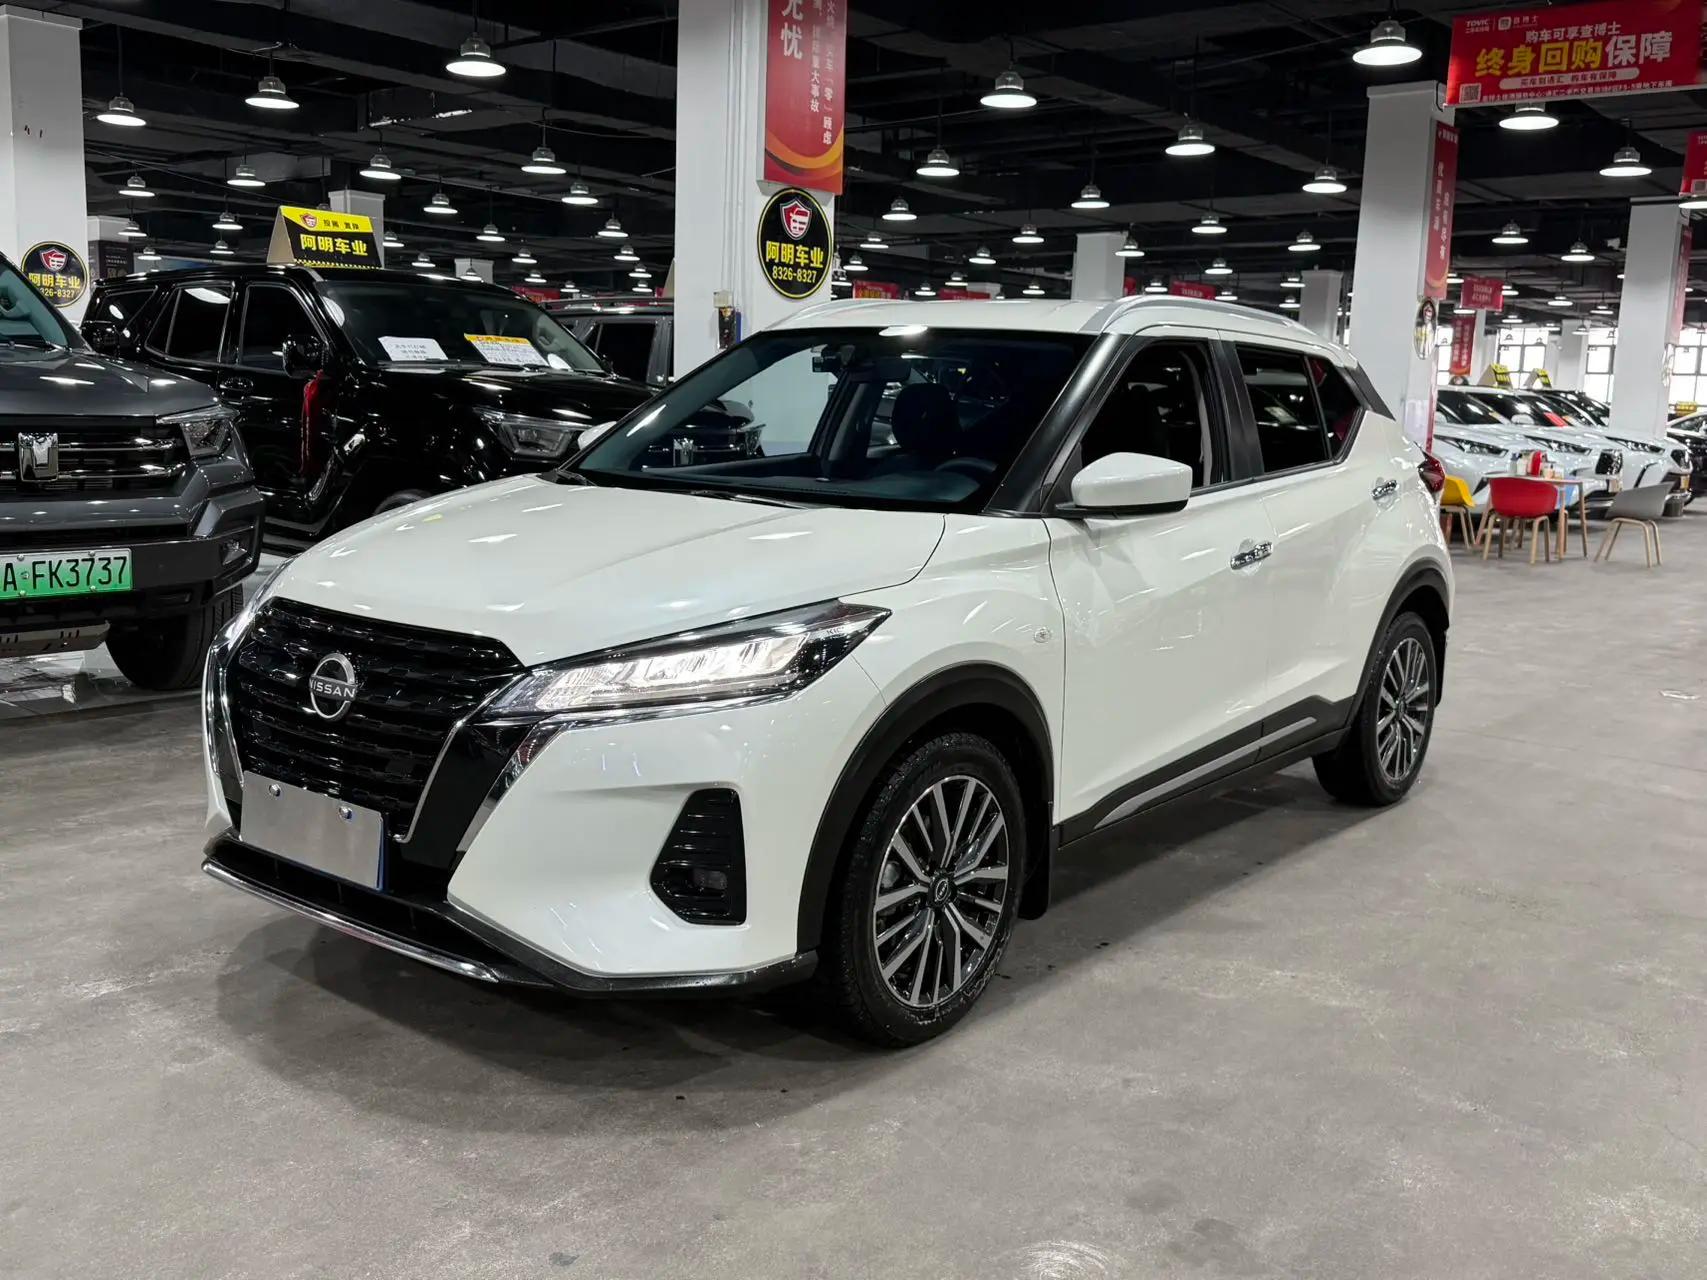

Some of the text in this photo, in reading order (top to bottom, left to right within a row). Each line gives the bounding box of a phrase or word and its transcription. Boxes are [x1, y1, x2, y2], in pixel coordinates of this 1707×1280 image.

[1525, 20, 1621, 43] 购车可享查博士
[1475, 30, 1673, 77] 终身回购保障
[300, 234, 368, 256] 阿明车业
[766, 241, 824, 268] 阿明车业
[28, 273, 81, 289] 阿明车业
[772, 266, 817, 284] 8326-8327
[309, 678, 356, 698] NISSAN
